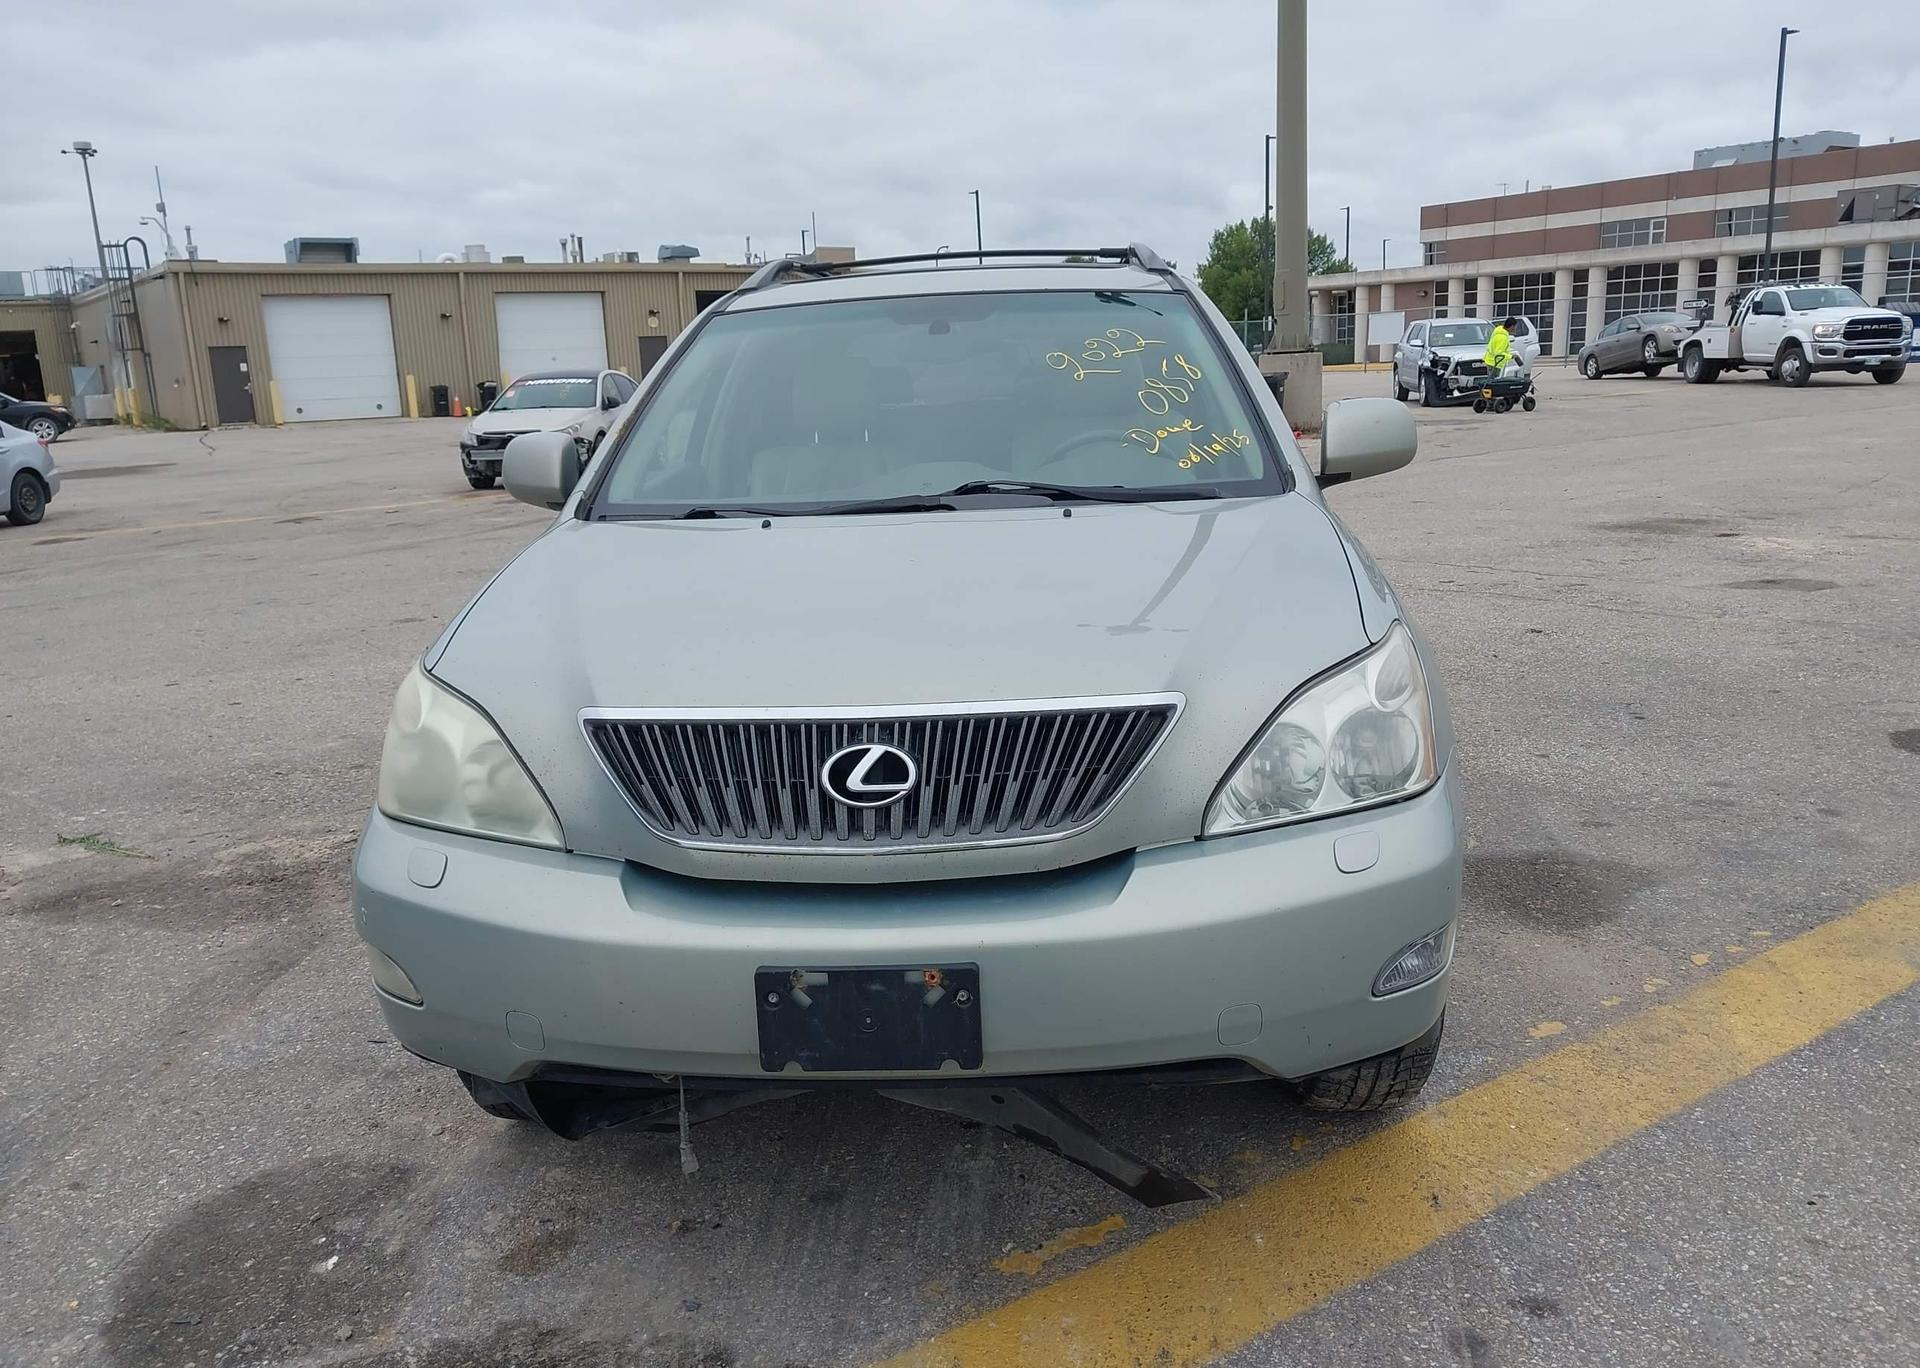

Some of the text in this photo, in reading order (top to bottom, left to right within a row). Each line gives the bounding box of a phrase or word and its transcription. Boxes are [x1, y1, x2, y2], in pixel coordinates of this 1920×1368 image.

[1046, 328, 1167, 381] 2022
[1138, 354, 1202, 415] 0858
[1178, 429, 1250, 469] 06/19/25
